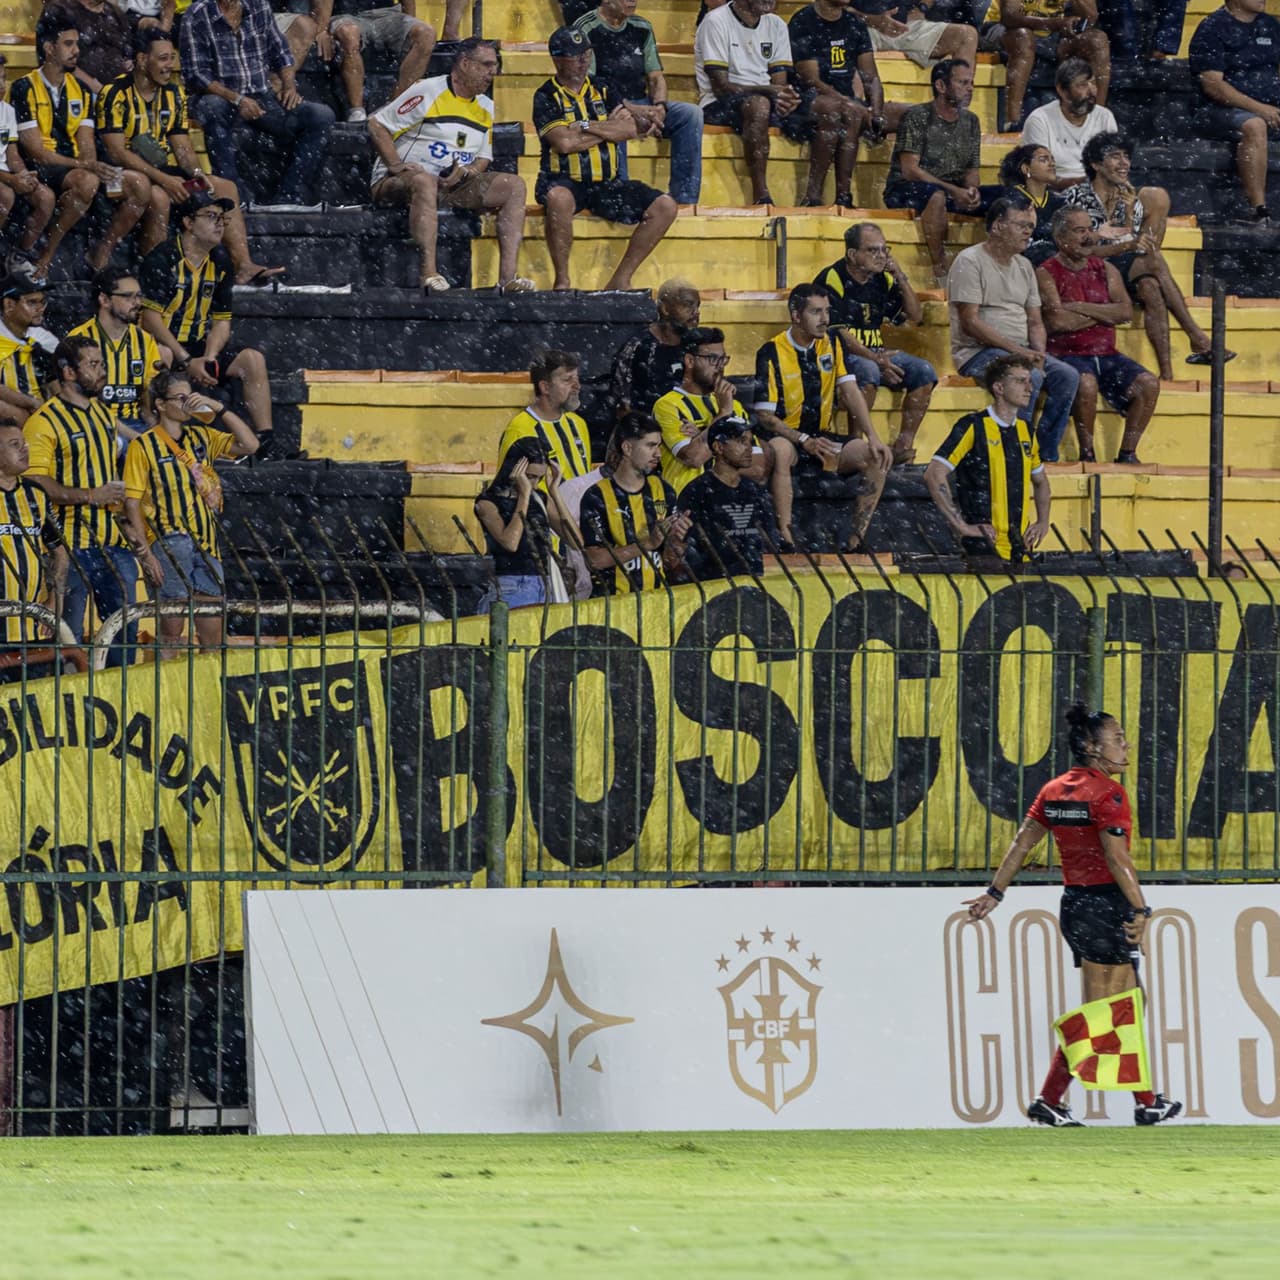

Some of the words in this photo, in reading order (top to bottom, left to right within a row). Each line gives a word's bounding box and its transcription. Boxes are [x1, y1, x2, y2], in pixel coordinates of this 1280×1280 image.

[237, 678, 354, 725] VRFC
[753, 1020, 790, 1038] CBF
[943, 908, 1210, 1123] COA
